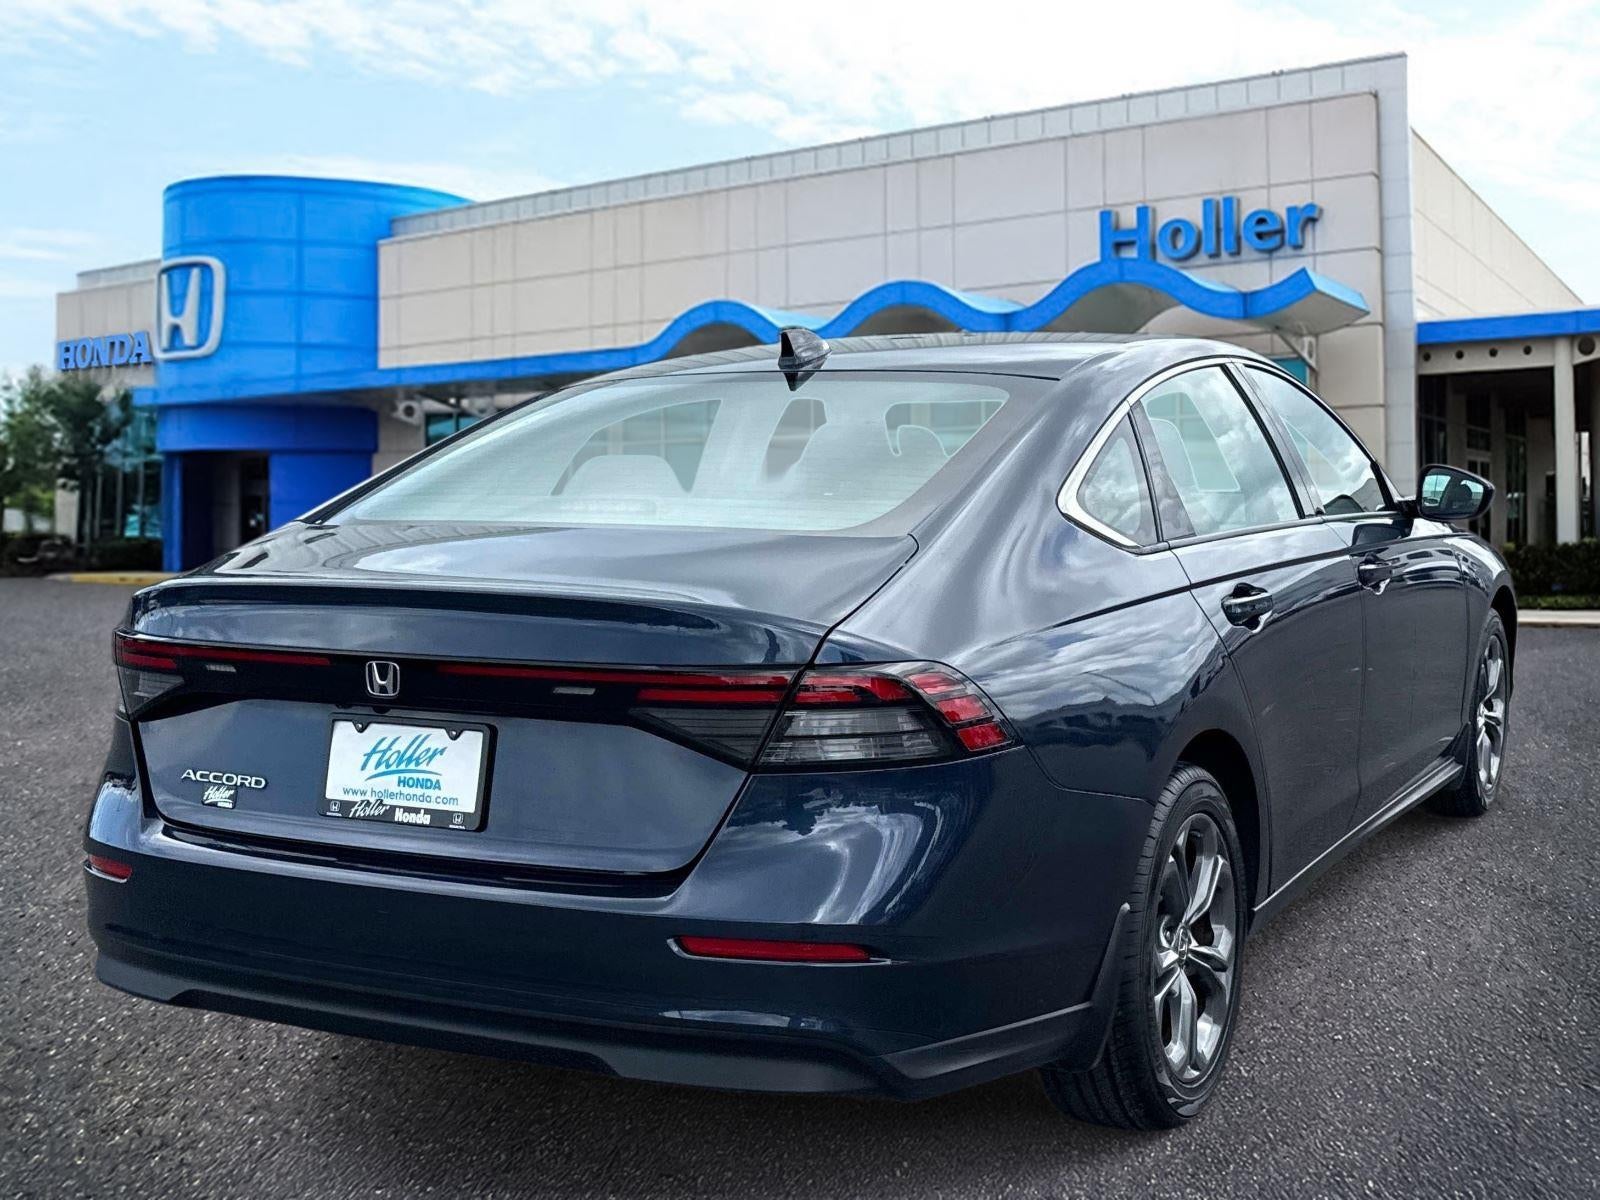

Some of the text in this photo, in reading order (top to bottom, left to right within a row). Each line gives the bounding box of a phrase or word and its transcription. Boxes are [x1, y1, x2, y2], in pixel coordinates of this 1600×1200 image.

[1099, 195, 1321, 261] Holler
[57, 331, 152, 371] HONDA
[360, 733, 448, 771] Holler
[181, 769, 266, 789] ACCORD
[397, 776, 442, 791] HONDA
[342, 786, 459, 806] www.hollerhonda.com
[349, 799, 431, 825] Holler Honda
